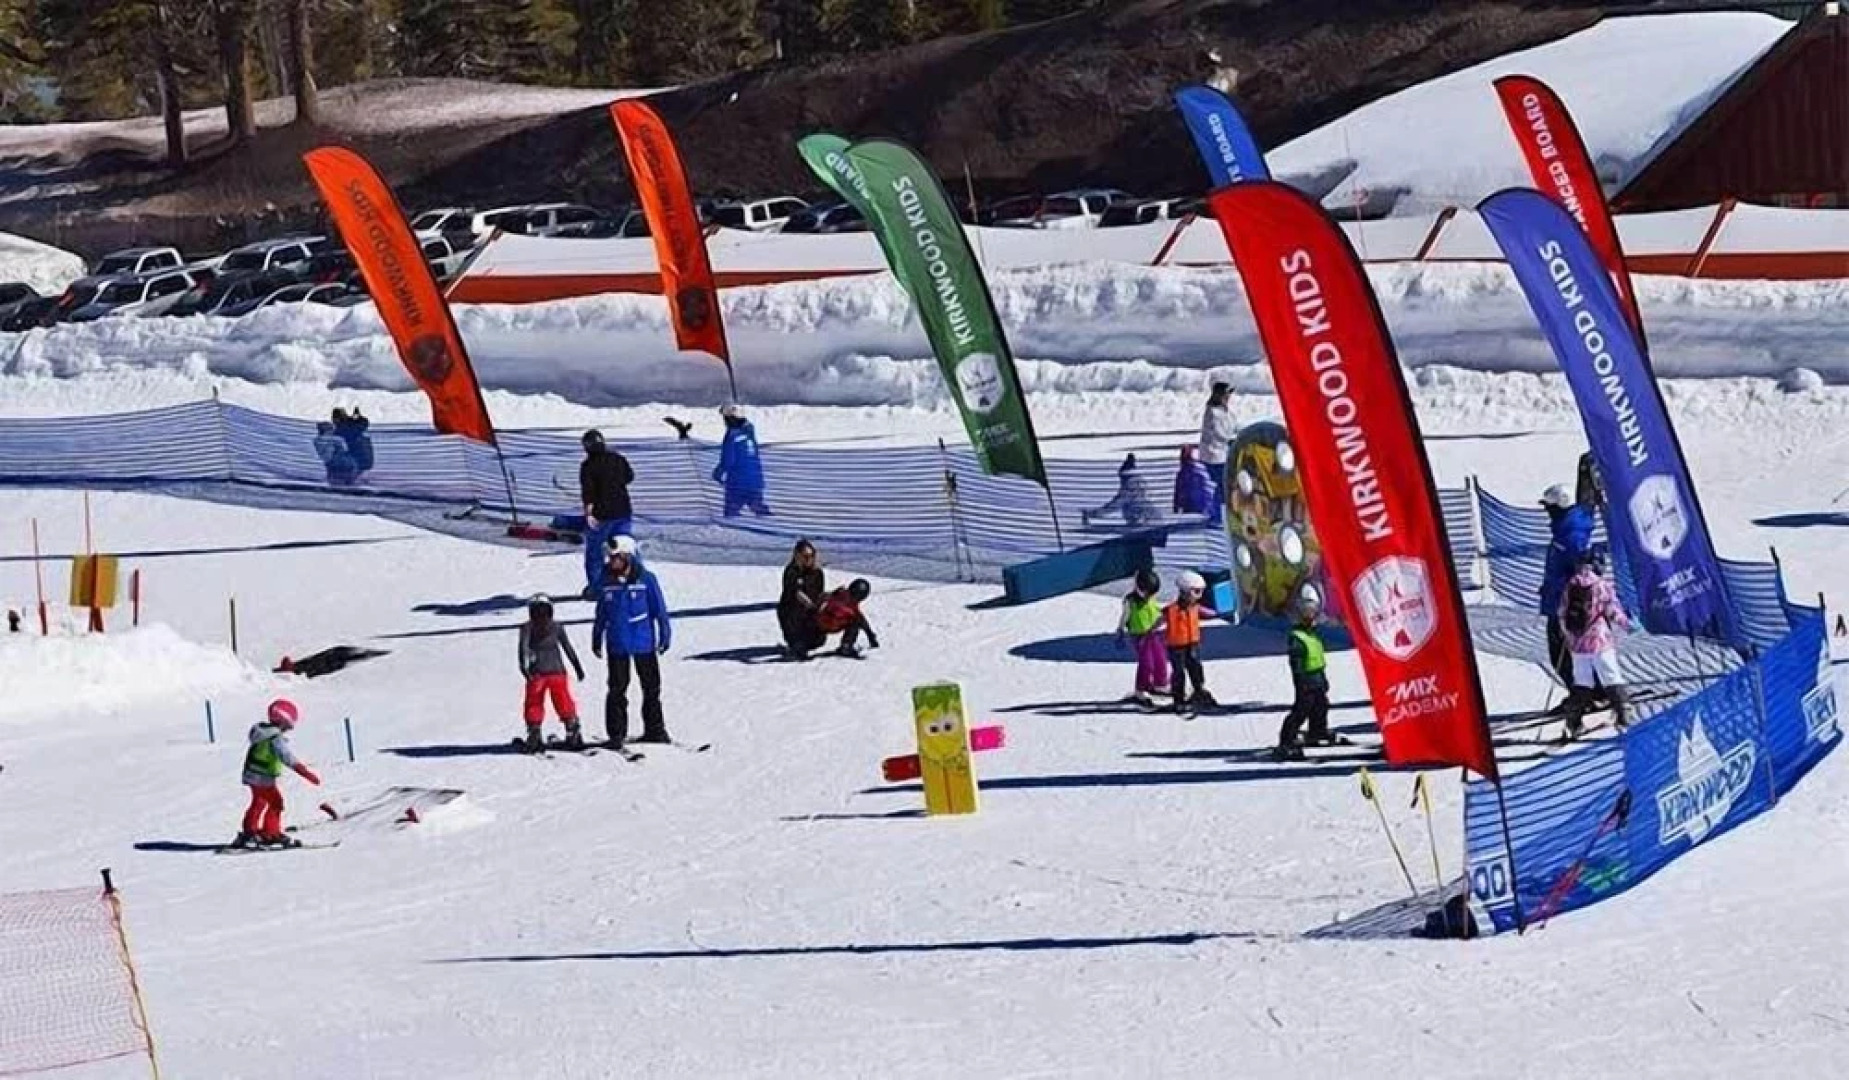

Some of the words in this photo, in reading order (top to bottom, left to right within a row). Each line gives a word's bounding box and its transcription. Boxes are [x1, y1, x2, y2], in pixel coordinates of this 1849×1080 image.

[1208, 112, 1236, 164] BOARD
[1522, 93, 1557, 158] BOARD
[347, 177, 374, 222] KIDS
[892, 175, 926, 228] KIDS
[1547, 156, 1590, 234] ANCED
[367, 226, 425, 326] KIRKWOOD
[914, 229, 975, 346] KIRKWOOD
[1280, 249, 1333, 338] KIDS
[1538, 240, 1586, 311] KIDS
[1574, 309, 1649, 467] KIRKWOOD
[1311, 342, 1394, 542] KIRKWOOD
[1661, 752, 1753, 827] KIRKWOOD
